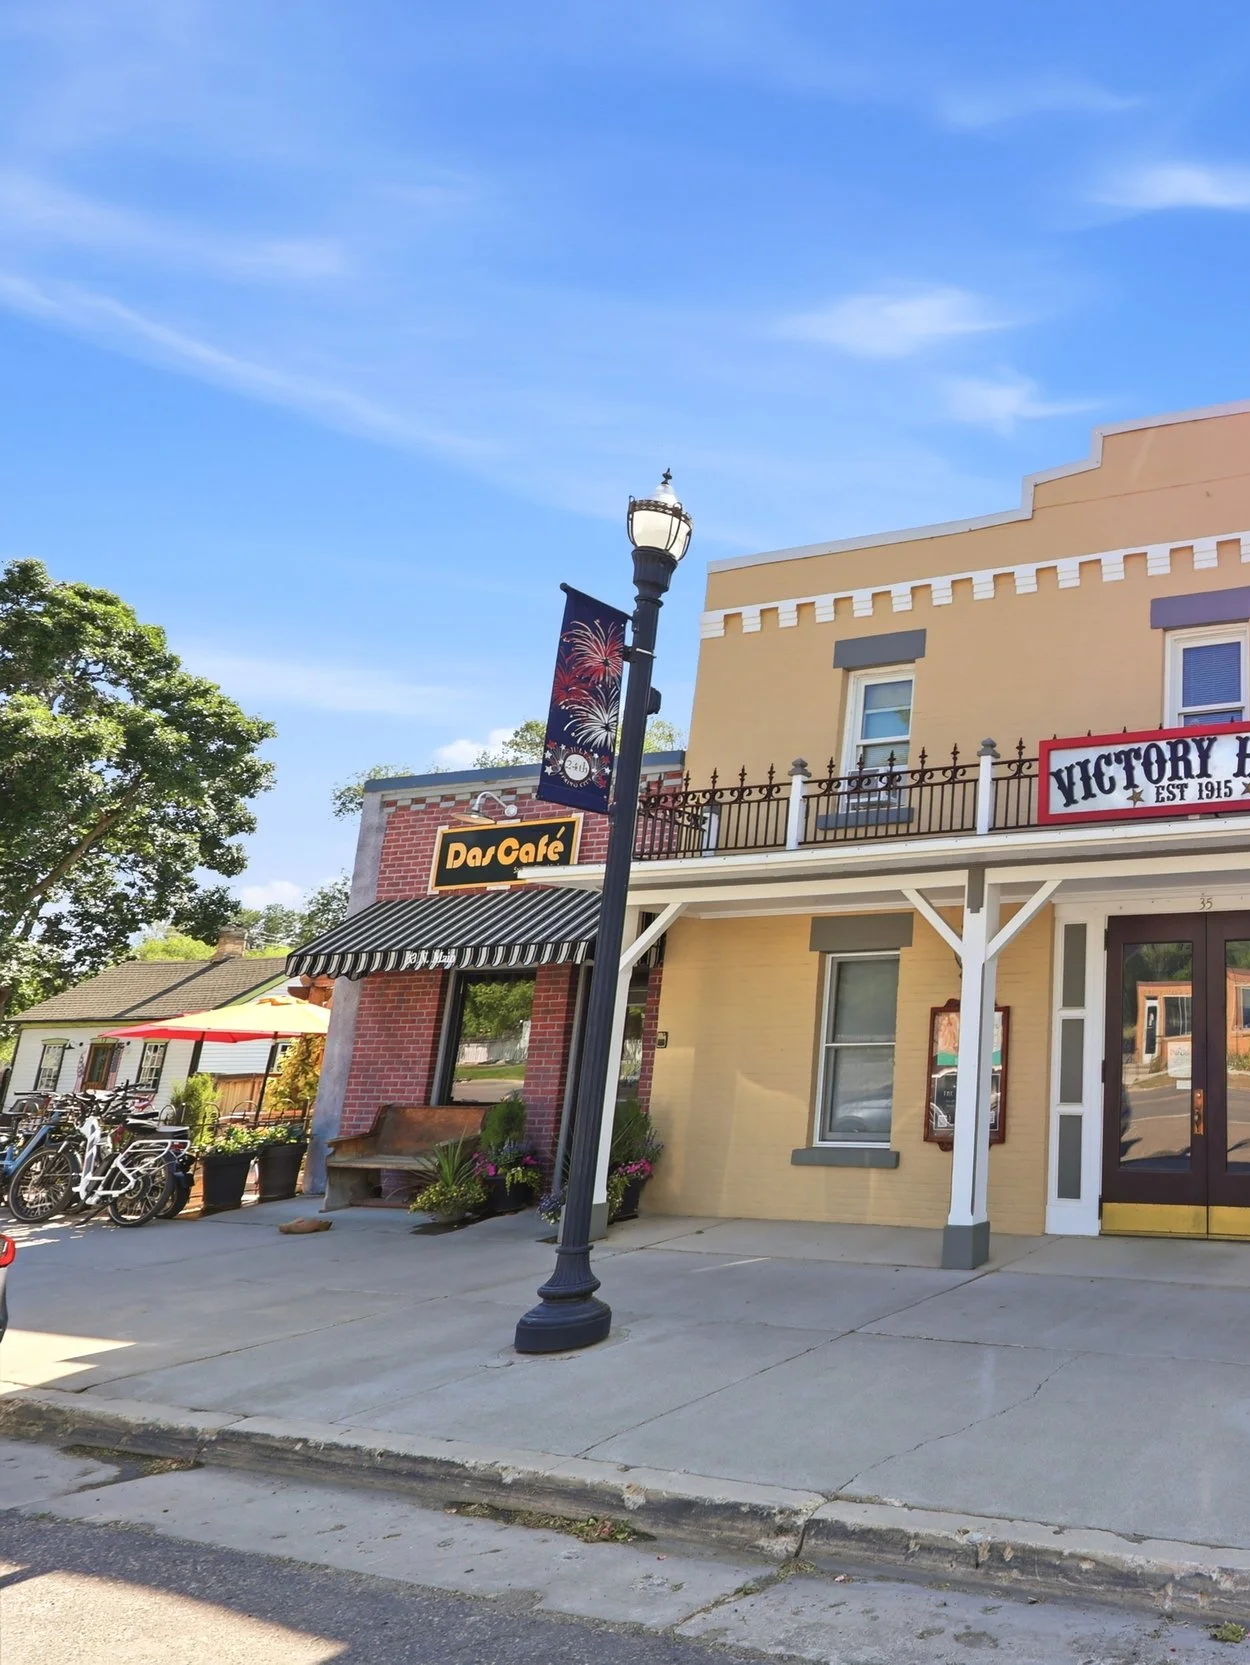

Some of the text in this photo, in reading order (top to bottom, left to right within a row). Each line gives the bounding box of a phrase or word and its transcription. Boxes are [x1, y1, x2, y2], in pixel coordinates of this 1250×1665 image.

[1050, 736, 1217, 807] VICTORY
[1155, 780, 1233, 803] EST 1915
[1199, 897, 1213, 911] 35
